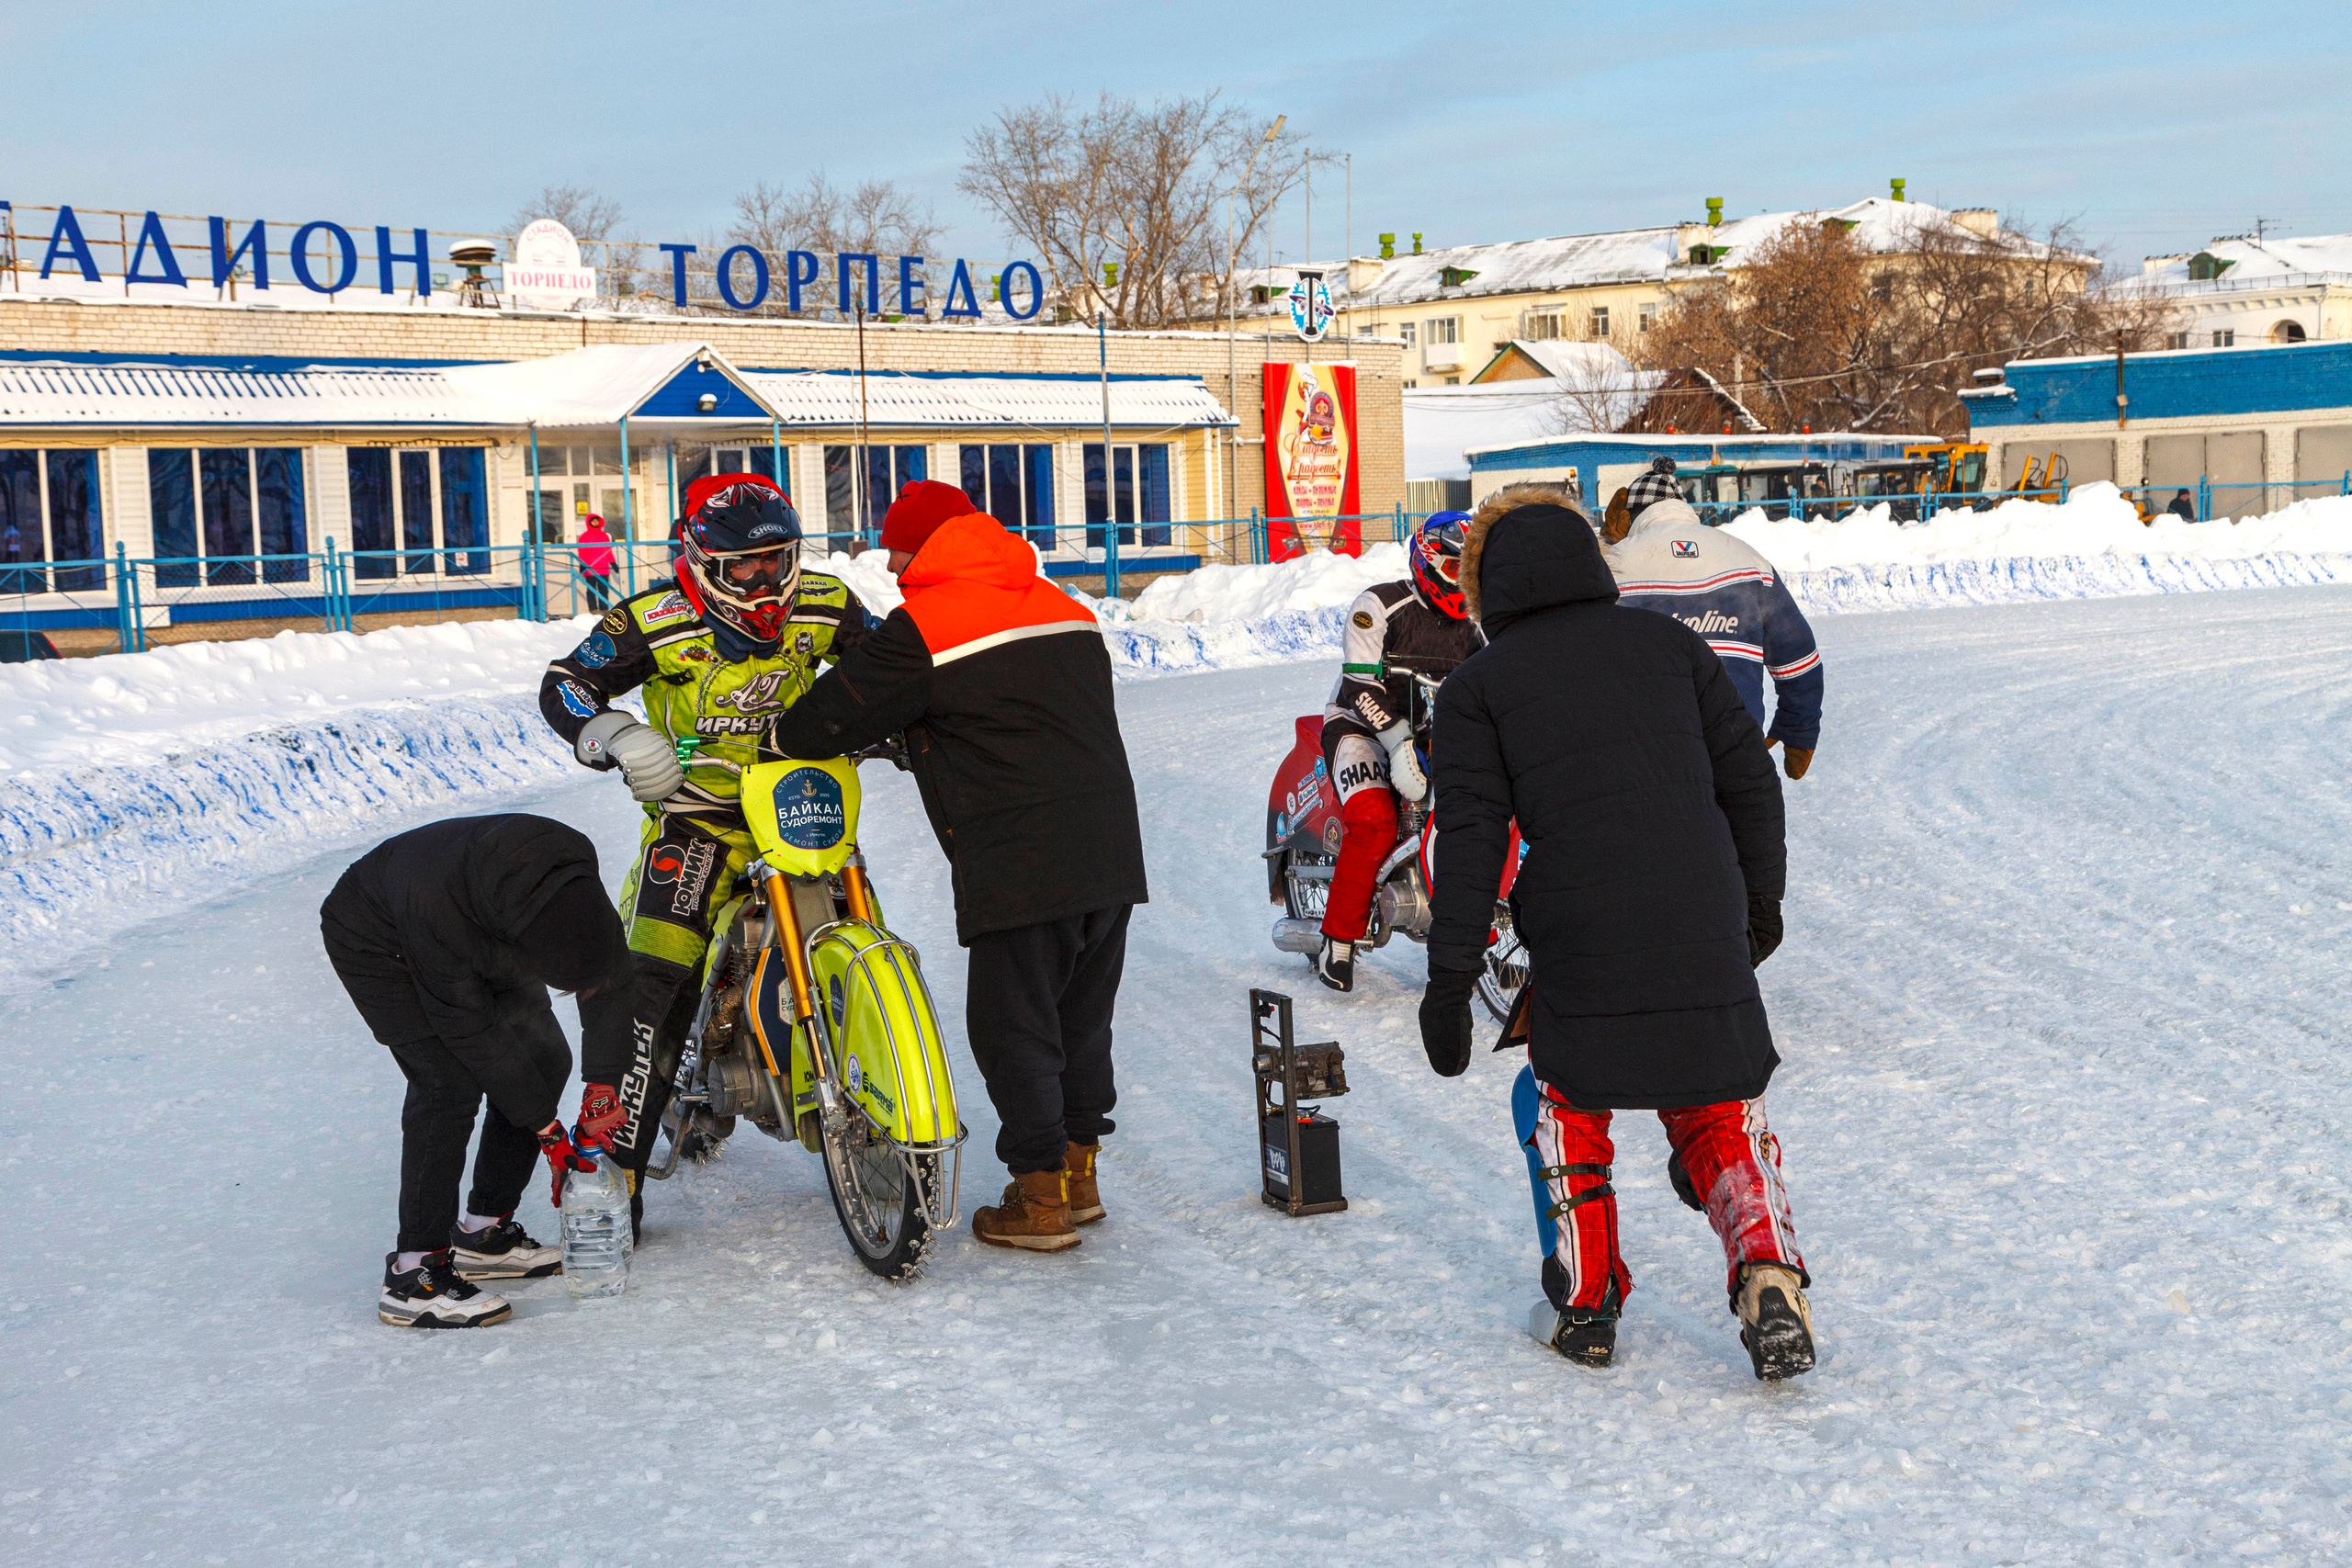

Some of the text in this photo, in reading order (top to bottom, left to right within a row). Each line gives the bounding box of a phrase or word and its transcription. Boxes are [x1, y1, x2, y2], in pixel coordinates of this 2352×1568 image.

[526, 223, 571, 244] СТАДИОН
[0, 200, 432, 297] АДИОН
[509, 271, 591, 290] ТОРПЕДО
[660, 243, 1044, 320] ТОРПЕДО
[754, 525, 783, 536] SHOEI
[1672, 610, 1739, 634] oline
[695, 711, 787, 734] ИРКУТ
[1355, 692, 1392, 730] SHAAZ
[776, 769, 838, 794] СТРОИТЕЛЬСТВО
[778, 800, 842, 819] БАЙКАЛ
[780, 816, 842, 829] СУДОРЕМОНТ
[784, 829, 842, 847] РЕМОНТ СУДОВ
[700, 841, 717, 878] КОМПАНИЯ
[672, 837, 711, 916] ЮМИК
